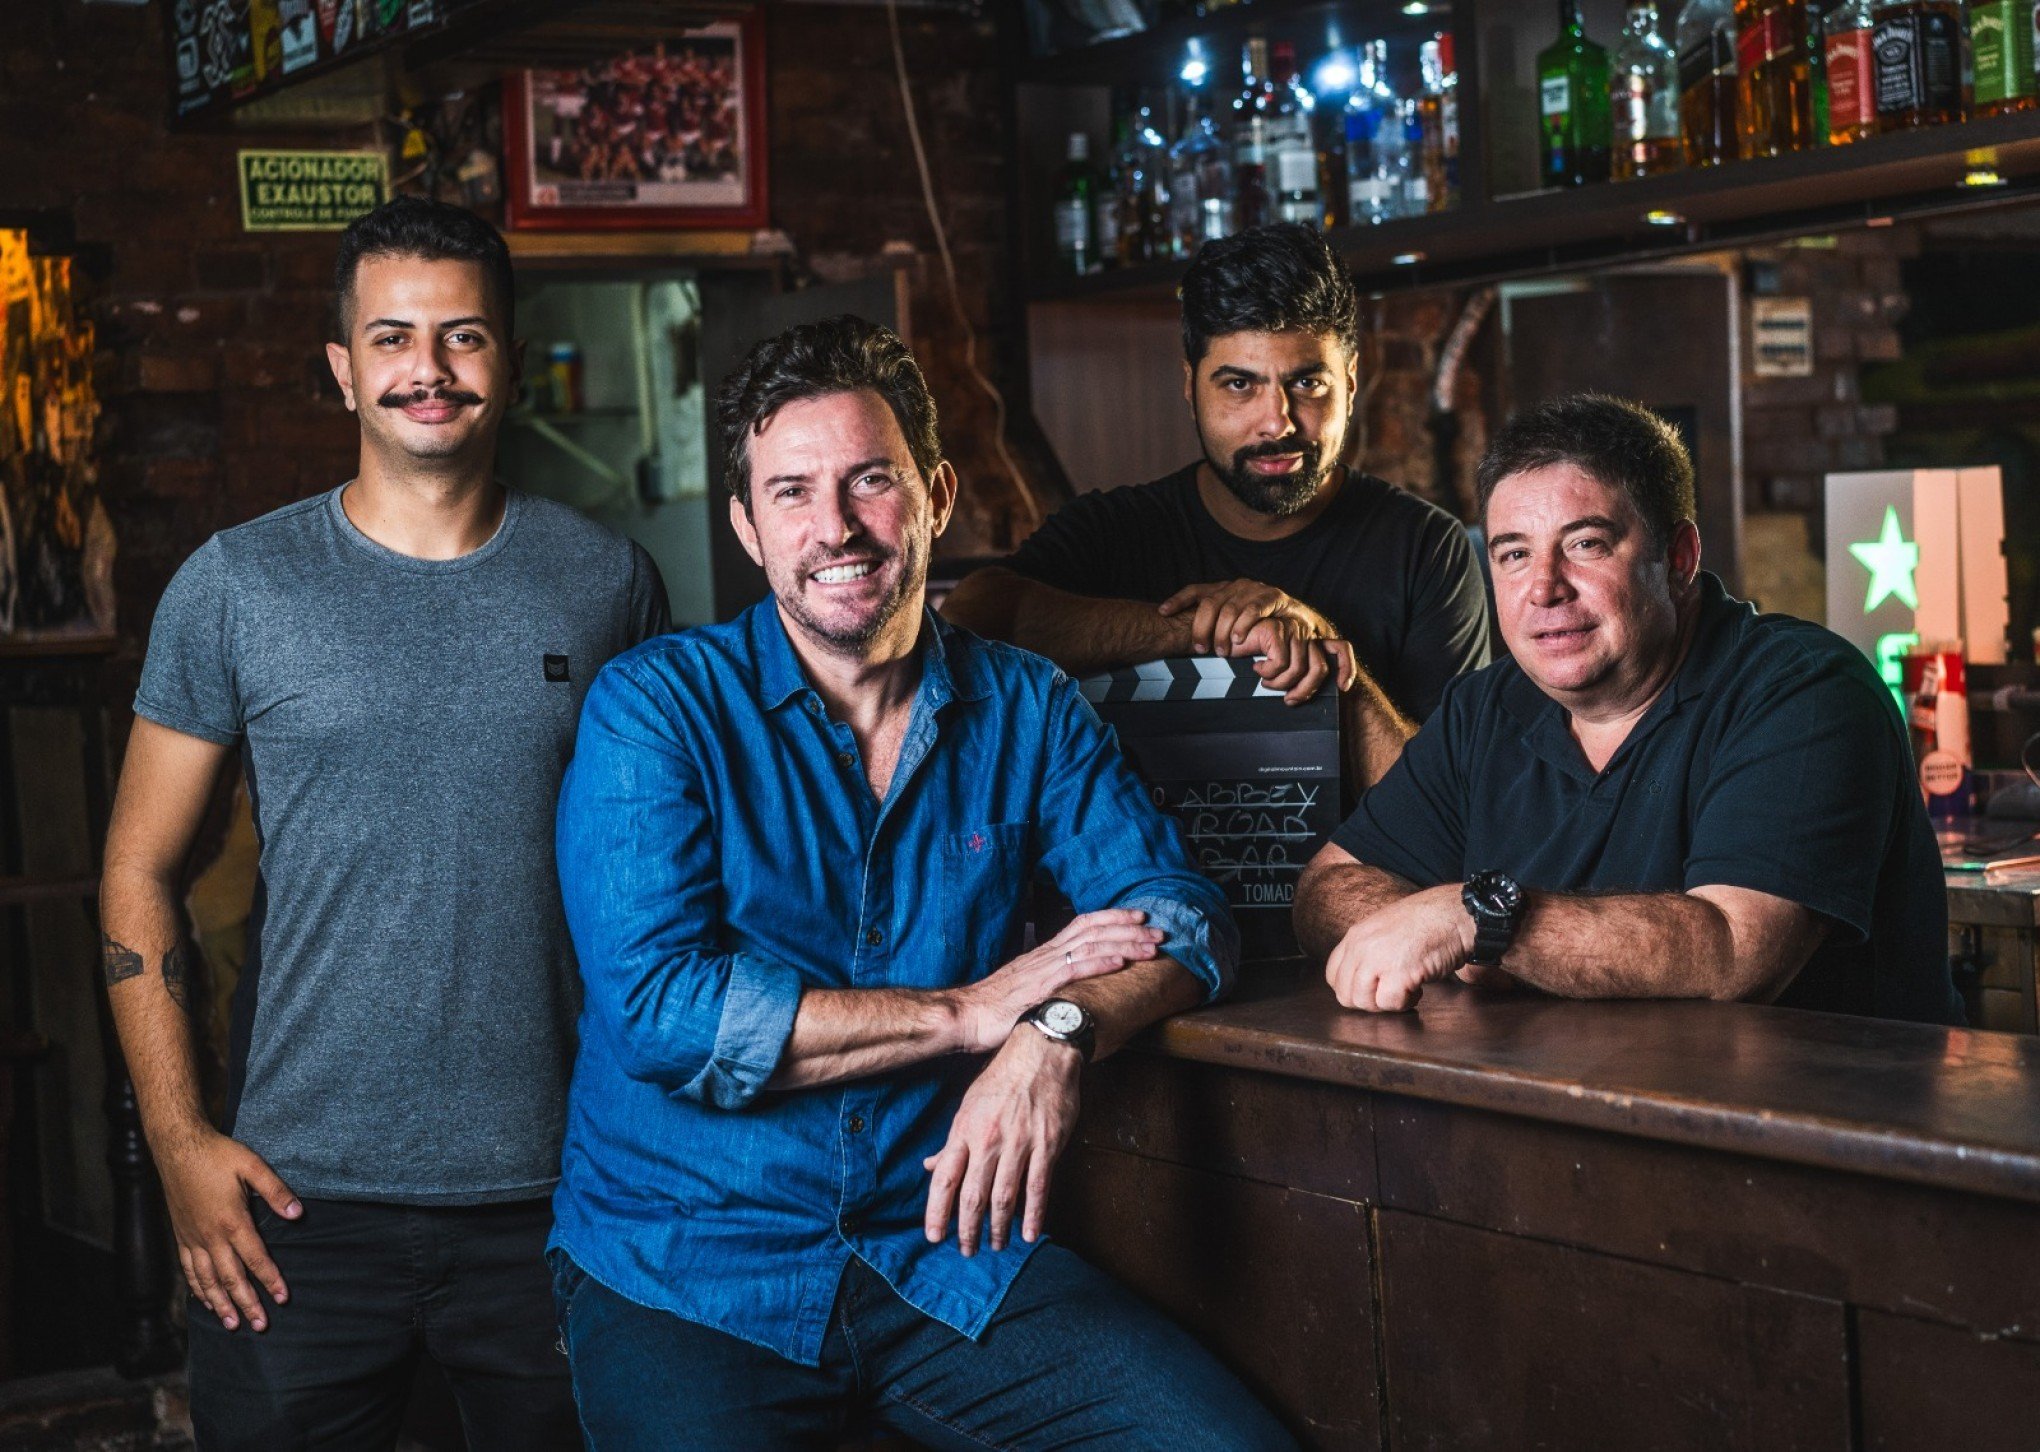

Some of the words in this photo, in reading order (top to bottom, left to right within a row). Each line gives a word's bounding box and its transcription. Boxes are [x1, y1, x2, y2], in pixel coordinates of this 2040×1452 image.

[250, 160, 378, 181] ACIONADOR
[257, 183, 376, 205] EXAUSTOR
[1181, 781, 1319, 818] ABBEY
[1190, 810, 1309, 845] ROAD
[1200, 844, 1299, 882] BAR
[1243, 884, 1294, 902] TOMAD
